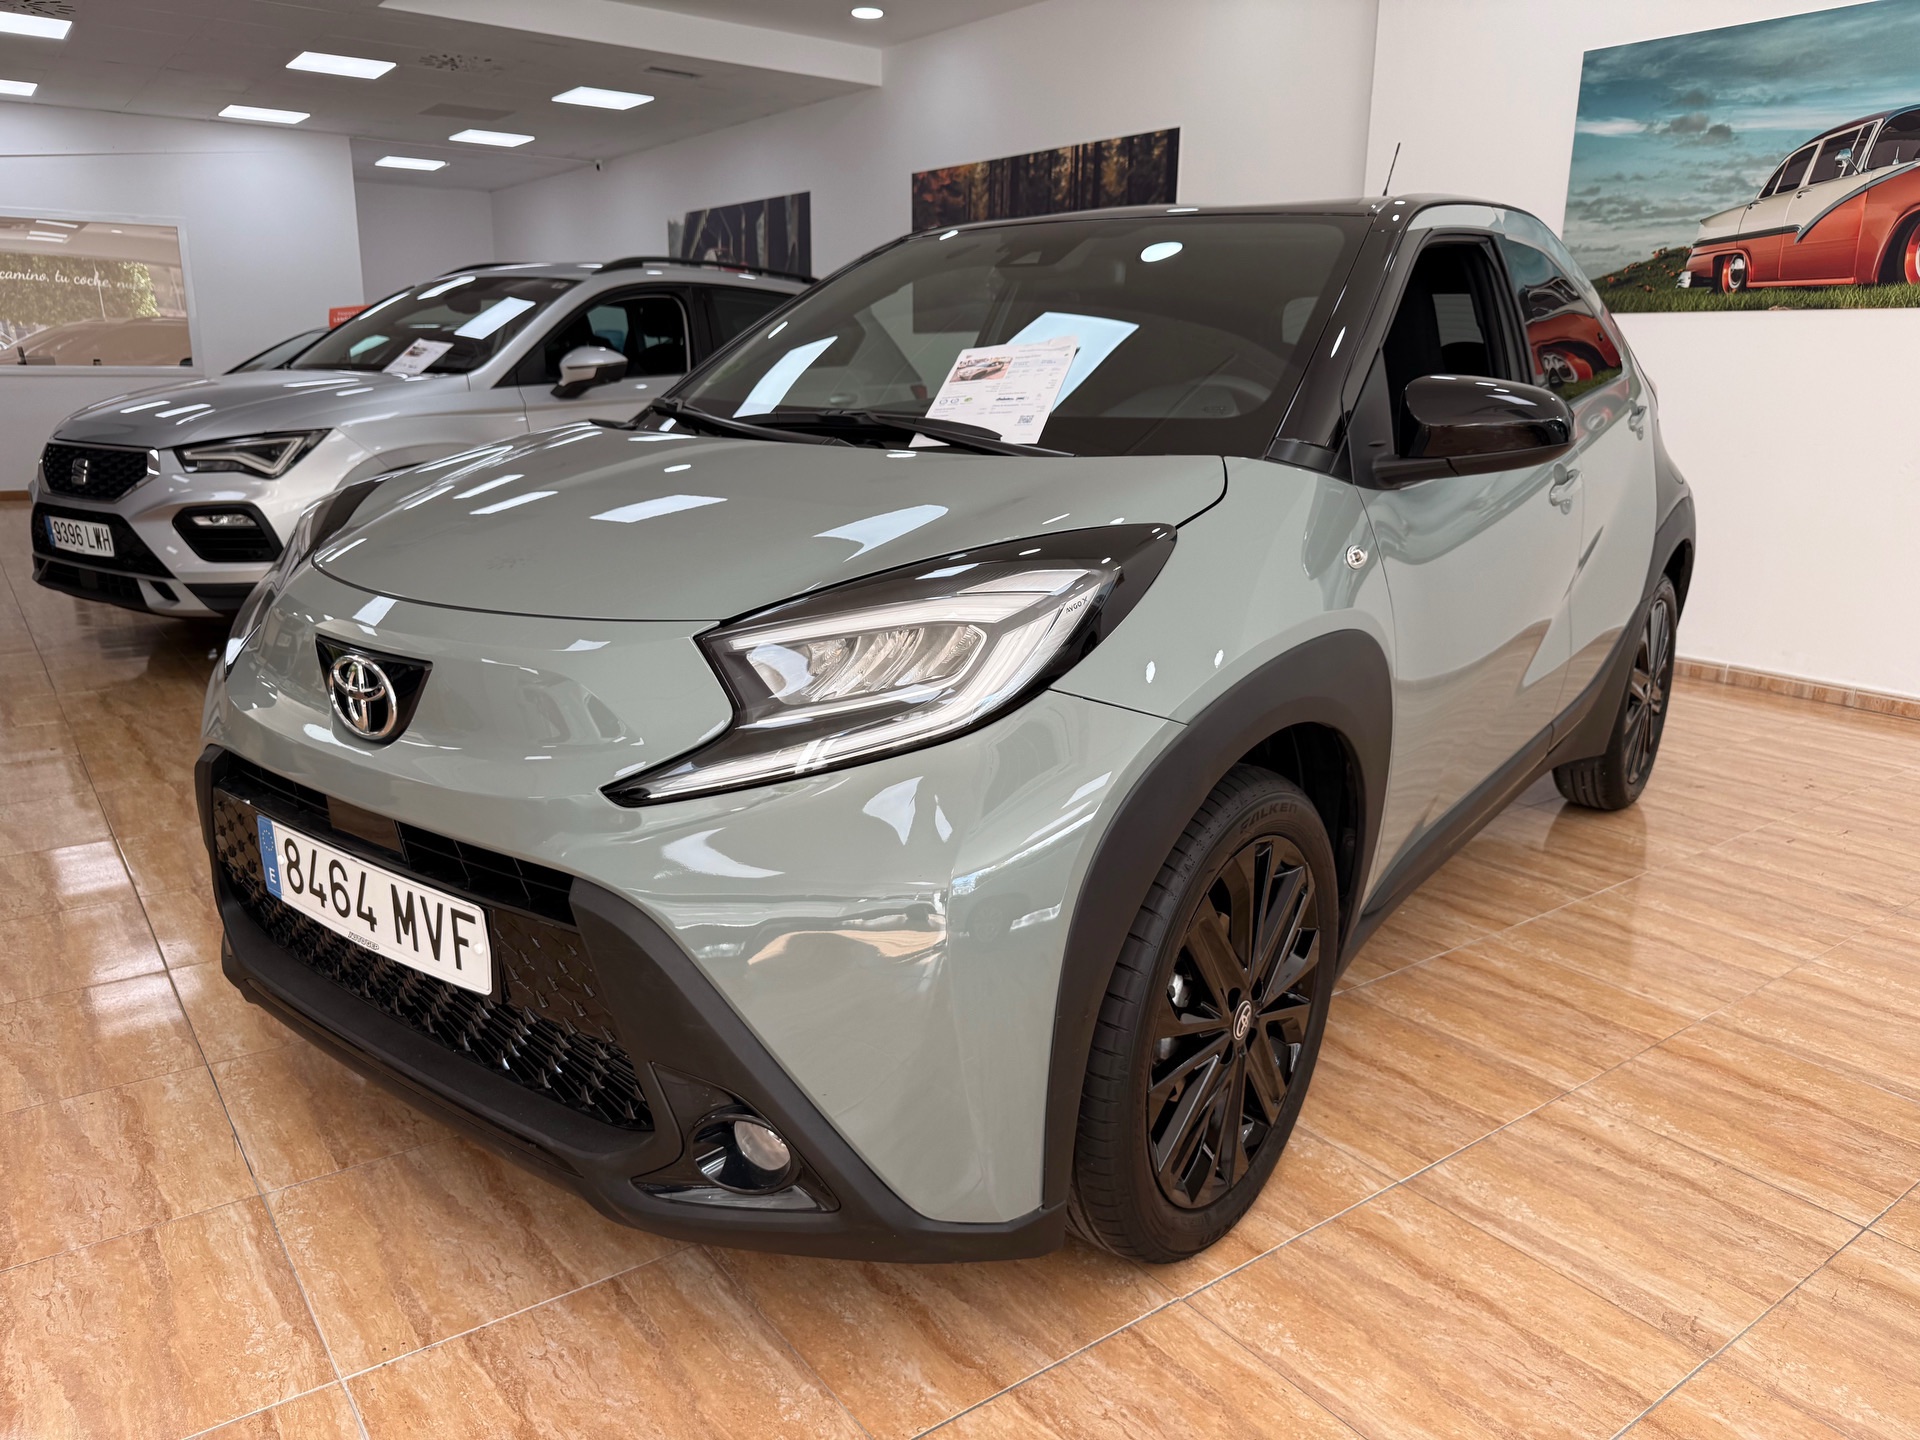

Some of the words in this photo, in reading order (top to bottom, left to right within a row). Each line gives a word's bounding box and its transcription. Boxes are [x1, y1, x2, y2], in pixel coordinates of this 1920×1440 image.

[54, 269, 69, 283] tu
[53, 521, 84, 545] 9396
[85, 525, 112, 551] LWH
[1240, 802, 1298, 834] FALKEN
[268, 867, 277, 884] E
[284, 837, 378, 933] 8464
[390, 883, 476, 971] MVF
